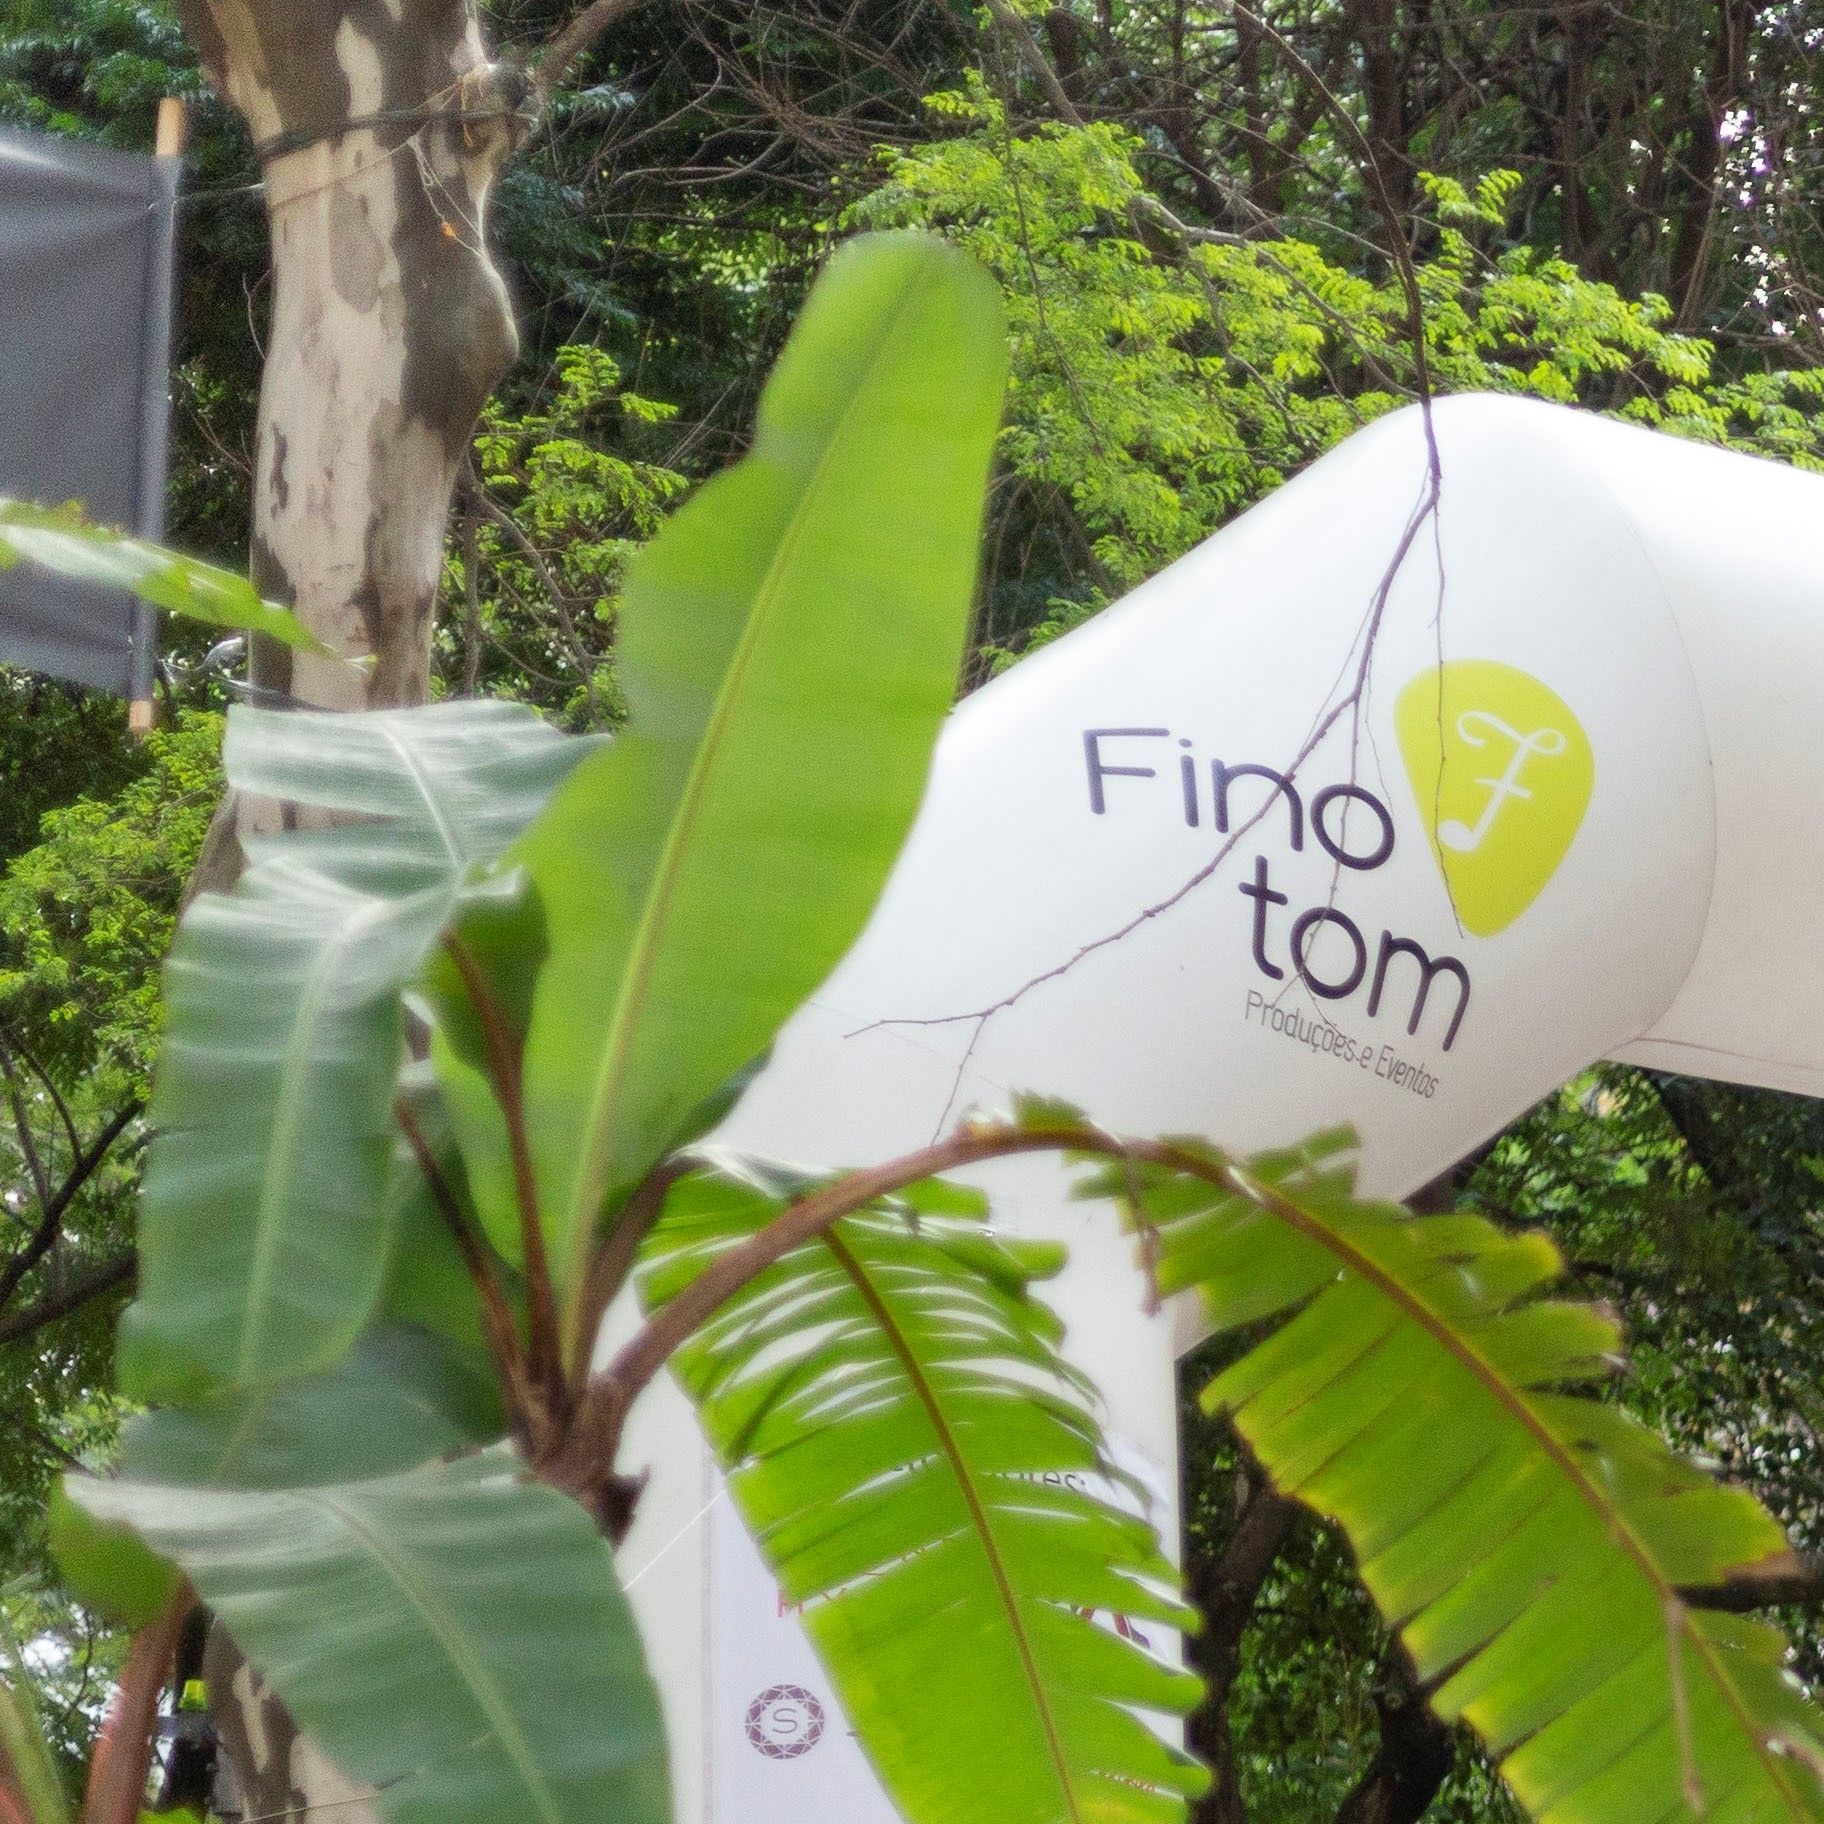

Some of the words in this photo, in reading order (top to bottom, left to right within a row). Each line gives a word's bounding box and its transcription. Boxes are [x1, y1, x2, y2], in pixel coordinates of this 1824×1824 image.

[1083, 728, 1396, 871] Fino
[1238, 855, 1471, 1052] tom
[1359, 1045, 1373, 1068] e
[1374, 1045, 1440, 1099] Eventos
